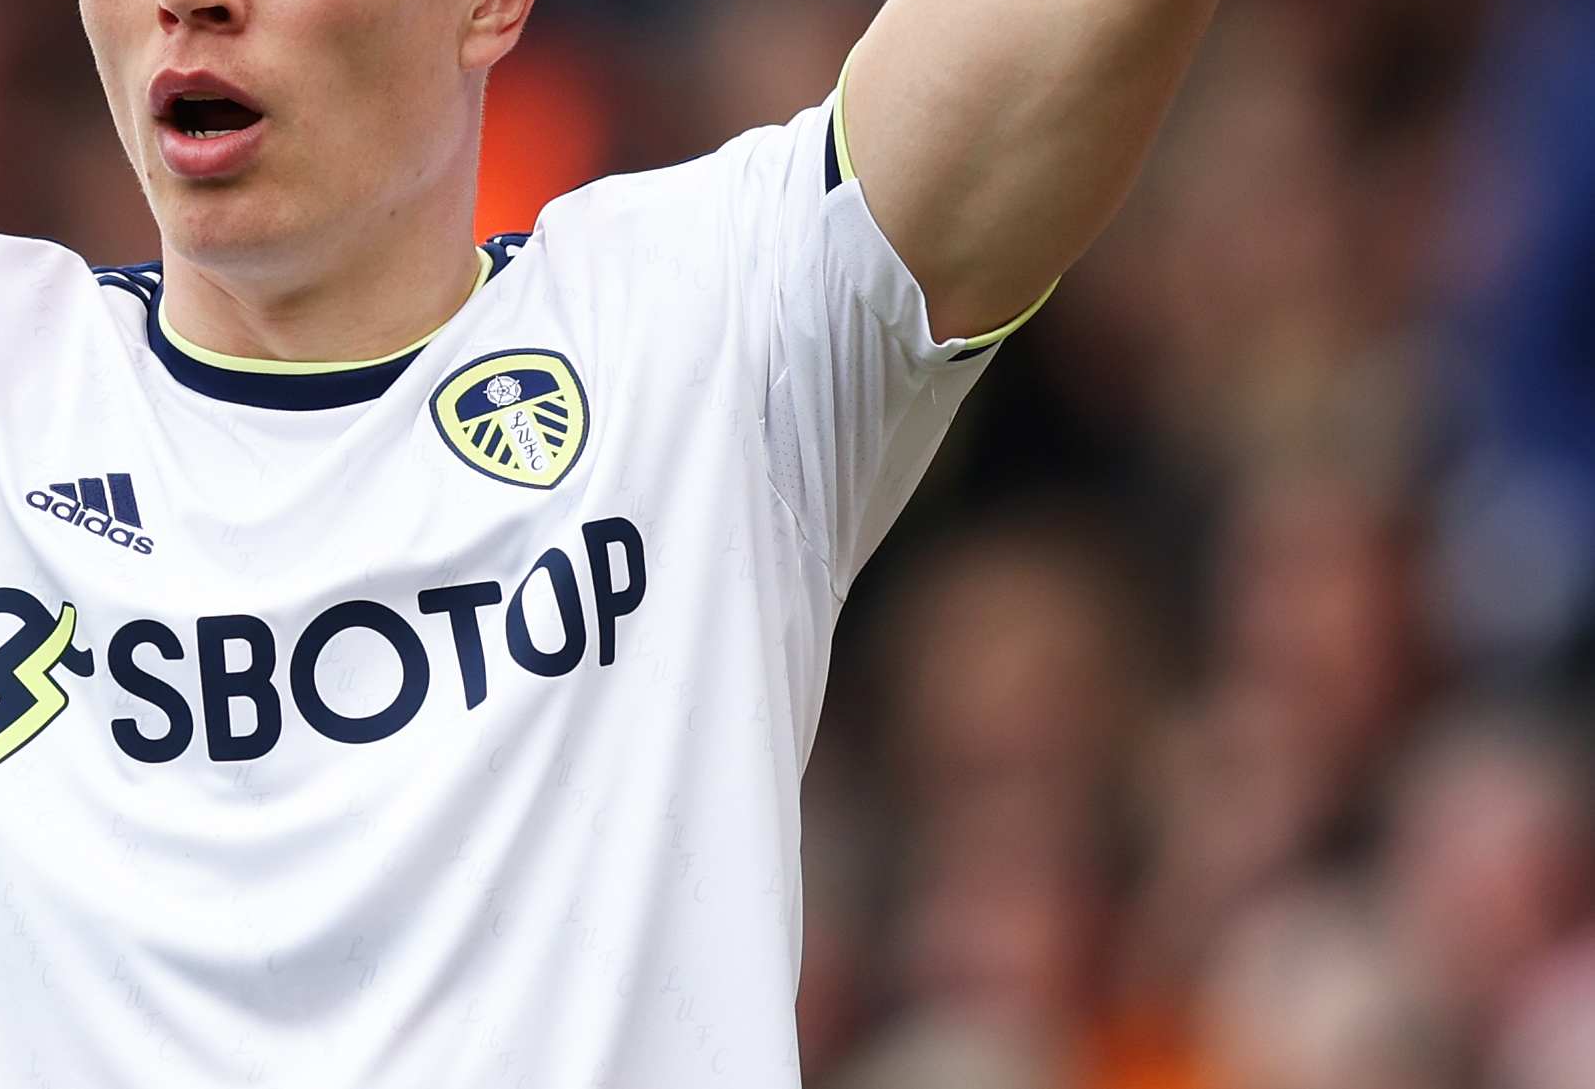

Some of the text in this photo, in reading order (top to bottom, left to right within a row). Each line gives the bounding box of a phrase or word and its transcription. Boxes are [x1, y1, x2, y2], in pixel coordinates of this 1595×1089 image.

[510, 411, 543, 471] LUFC
[25, 490, 155, 555] adidas
[107, 516, 647, 764] SBOTOP
